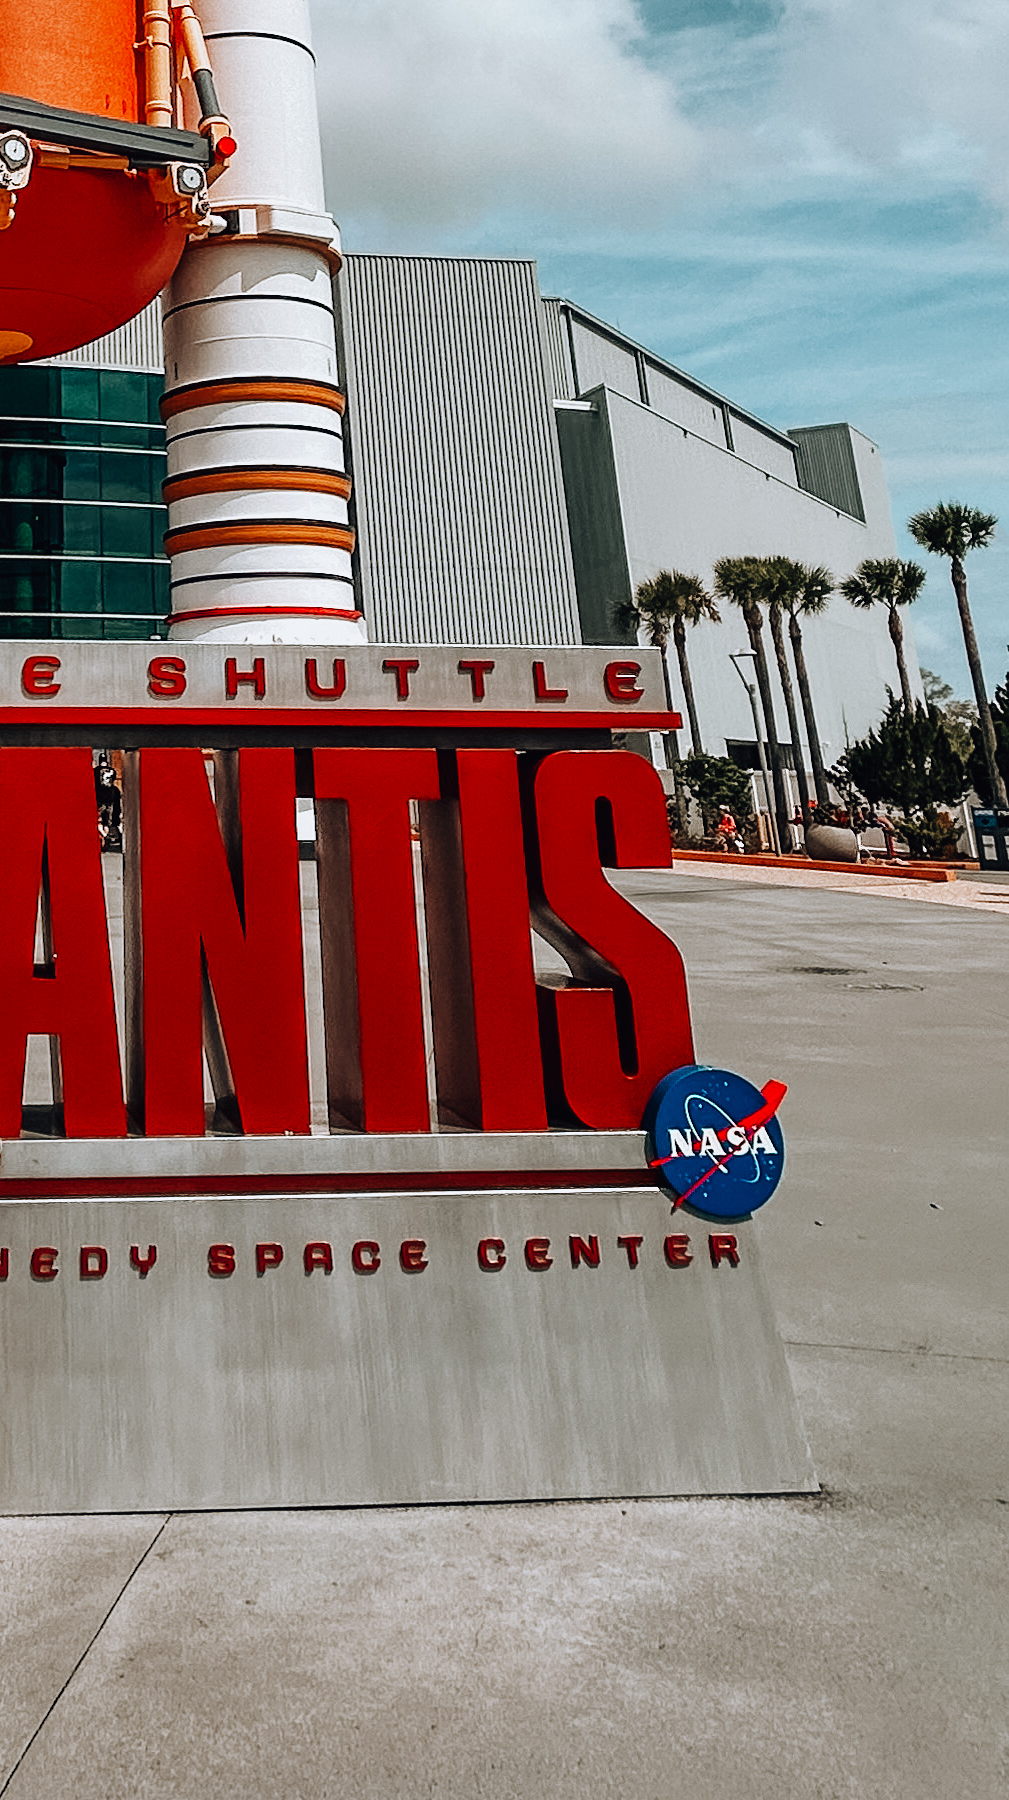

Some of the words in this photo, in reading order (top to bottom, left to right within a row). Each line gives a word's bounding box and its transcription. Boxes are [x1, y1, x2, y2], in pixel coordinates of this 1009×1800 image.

[147, 655, 645, 701] SHUTTLE
[668, 1126, 778, 1158] NASA
[207, 1240, 429, 1278] SPACE
[477, 1233, 740, 1273] CENTER
